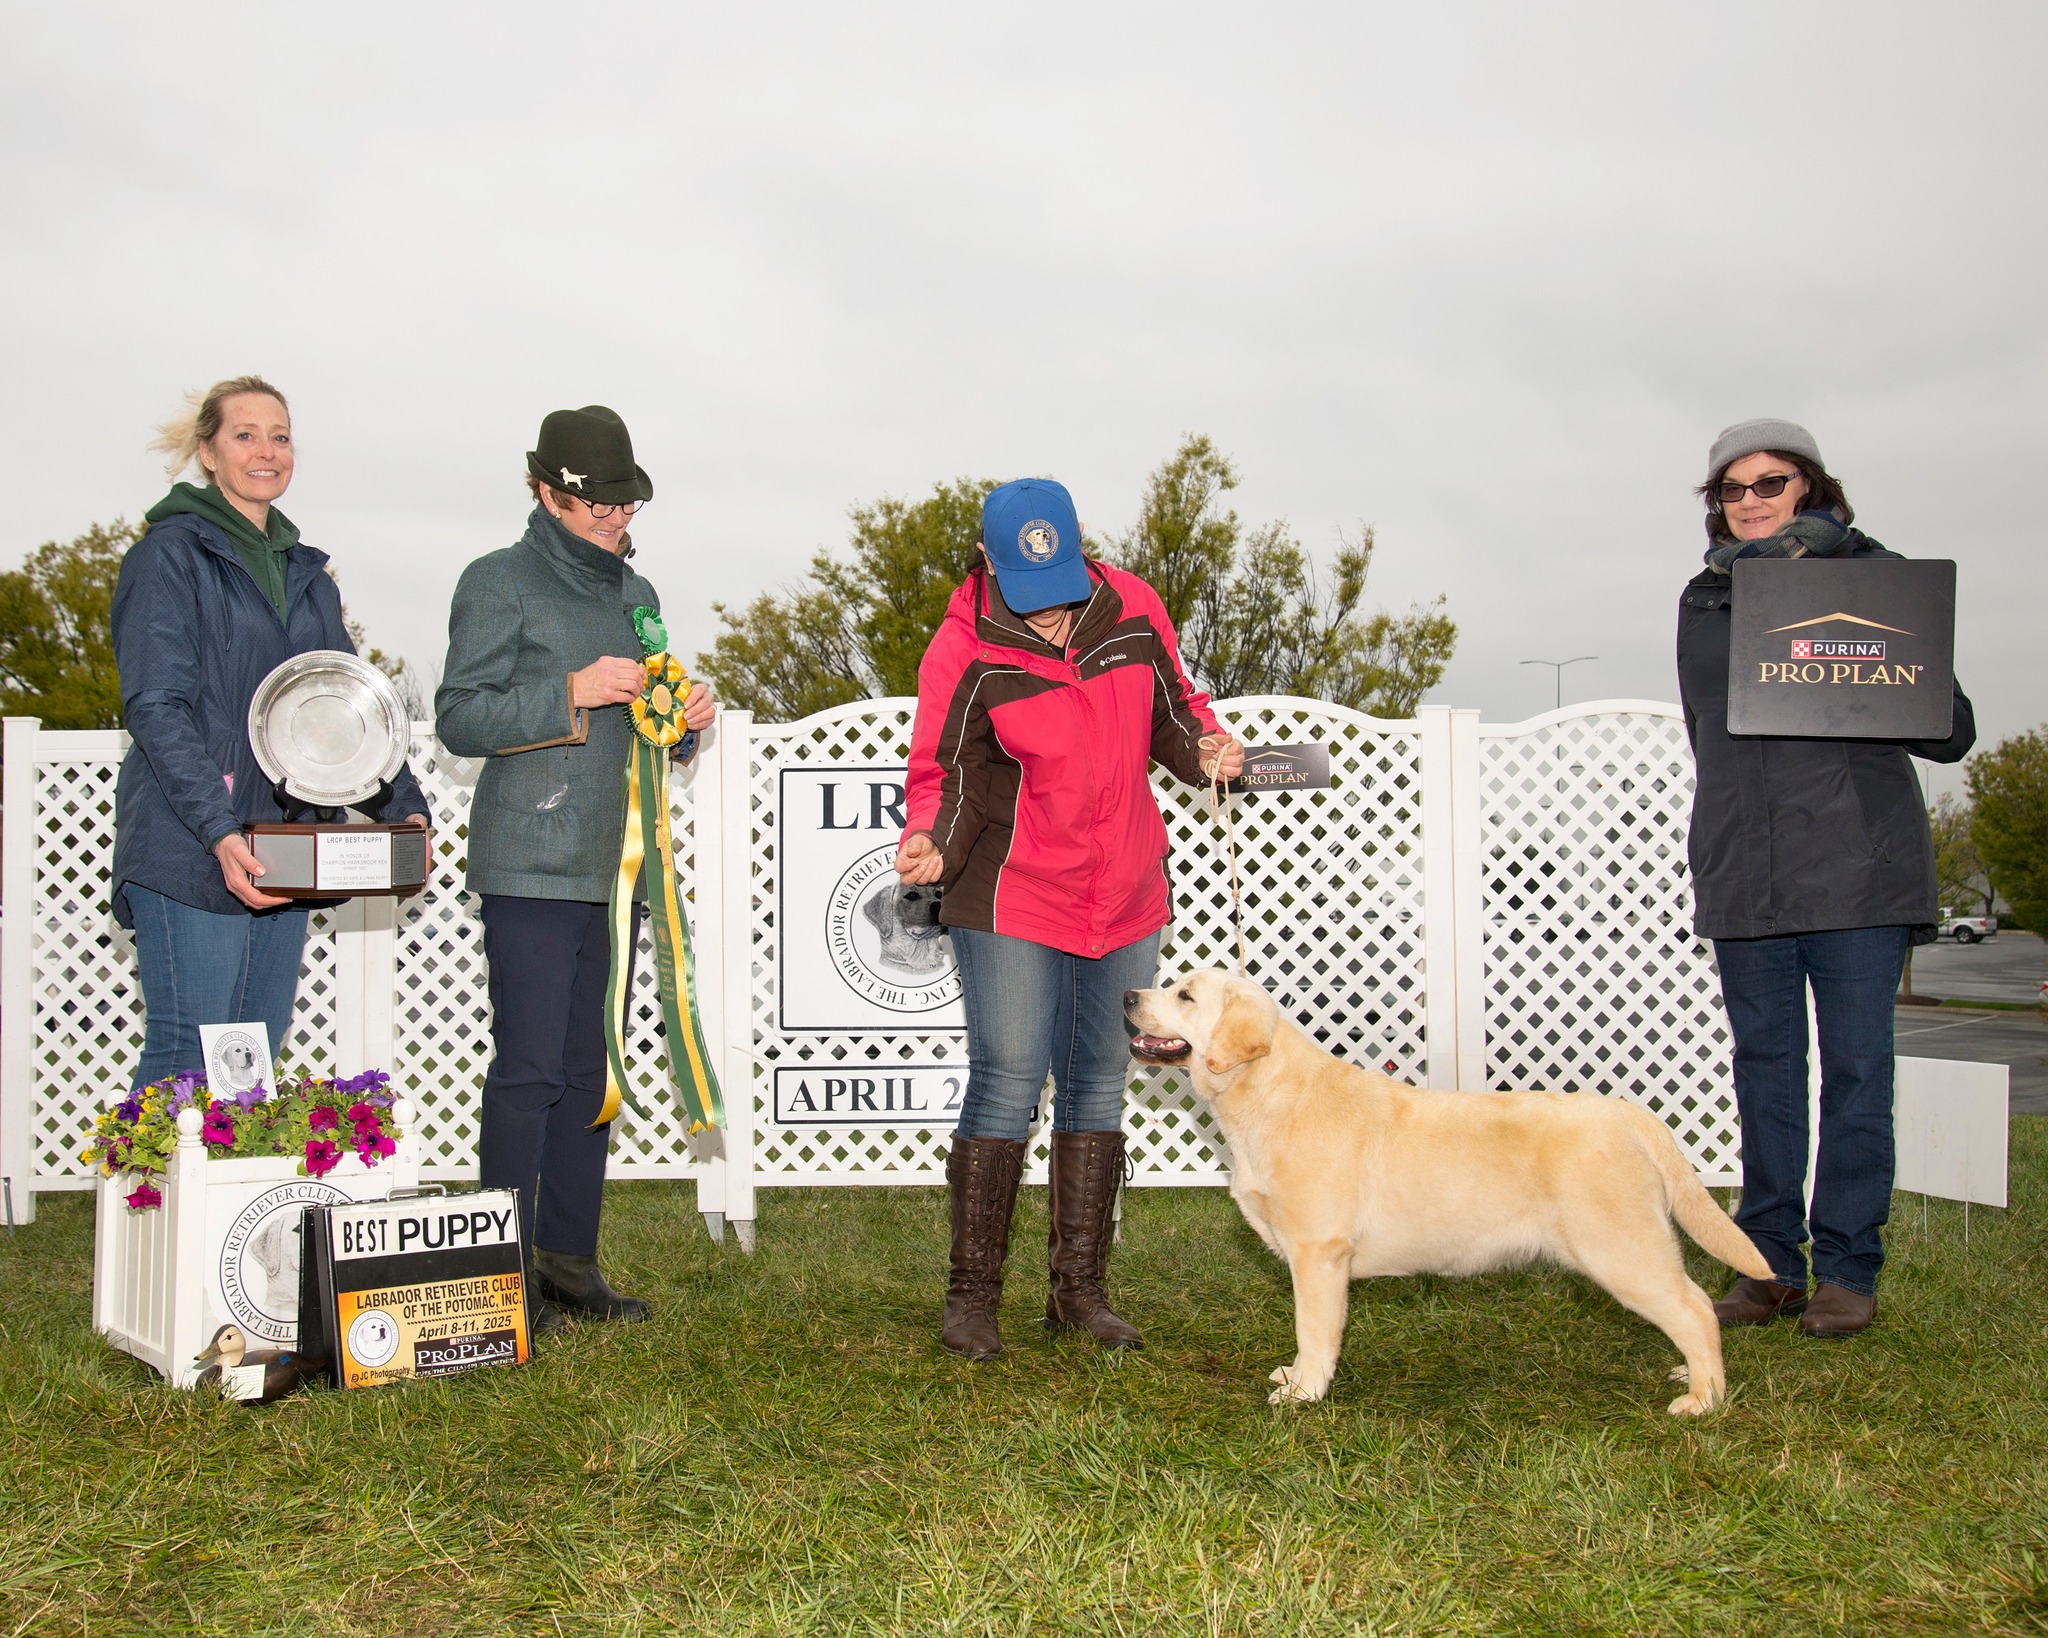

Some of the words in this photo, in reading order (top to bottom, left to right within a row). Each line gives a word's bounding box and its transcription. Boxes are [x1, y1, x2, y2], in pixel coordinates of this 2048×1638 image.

[1814, 644, 1880, 656] PURINA
[1758, 662, 1826, 684] PRO
[1240, 774, 1268, 785] PRO
[816, 782, 907, 830] LR
[326, 836, 343, 844] LRCP
[344, 836, 360, 844] BEST
[362, 836, 383, 844] PUPPY
[832, 914, 878, 993] LABRADOR
[876, 988, 908, 1005] THE
[788, 1077, 929, 1112] APRIL
[298, 1185, 336, 1204] CLUB
[227, 1188, 295, 1252] RETRIEVER
[343, 1219, 388, 1253] BEST
[398, 1209, 512, 1252] PUPPY
[224, 1255, 263, 1331] LABRADOR
[356, 1288, 422, 1310] LABRADOR
[425, 1280, 490, 1301] RETRIEVER
[492, 1276, 520, 1292] CLUB
[404, 1305, 417, 1319] OF
[420, 1301, 442, 1316] THE
[446, 1294, 500, 1314] POTOMAC,
[502, 1292, 522, 1306] INC.
[262, 1322, 292, 1338] THE
[418, 1324, 448, 1341] April
[451, 1319, 479, 1334] 8-11,
[484, 1315, 512, 1330] 2025
[456, 1335, 482, 1344] PURINA
[360, 1371, 368, 1380] JC
